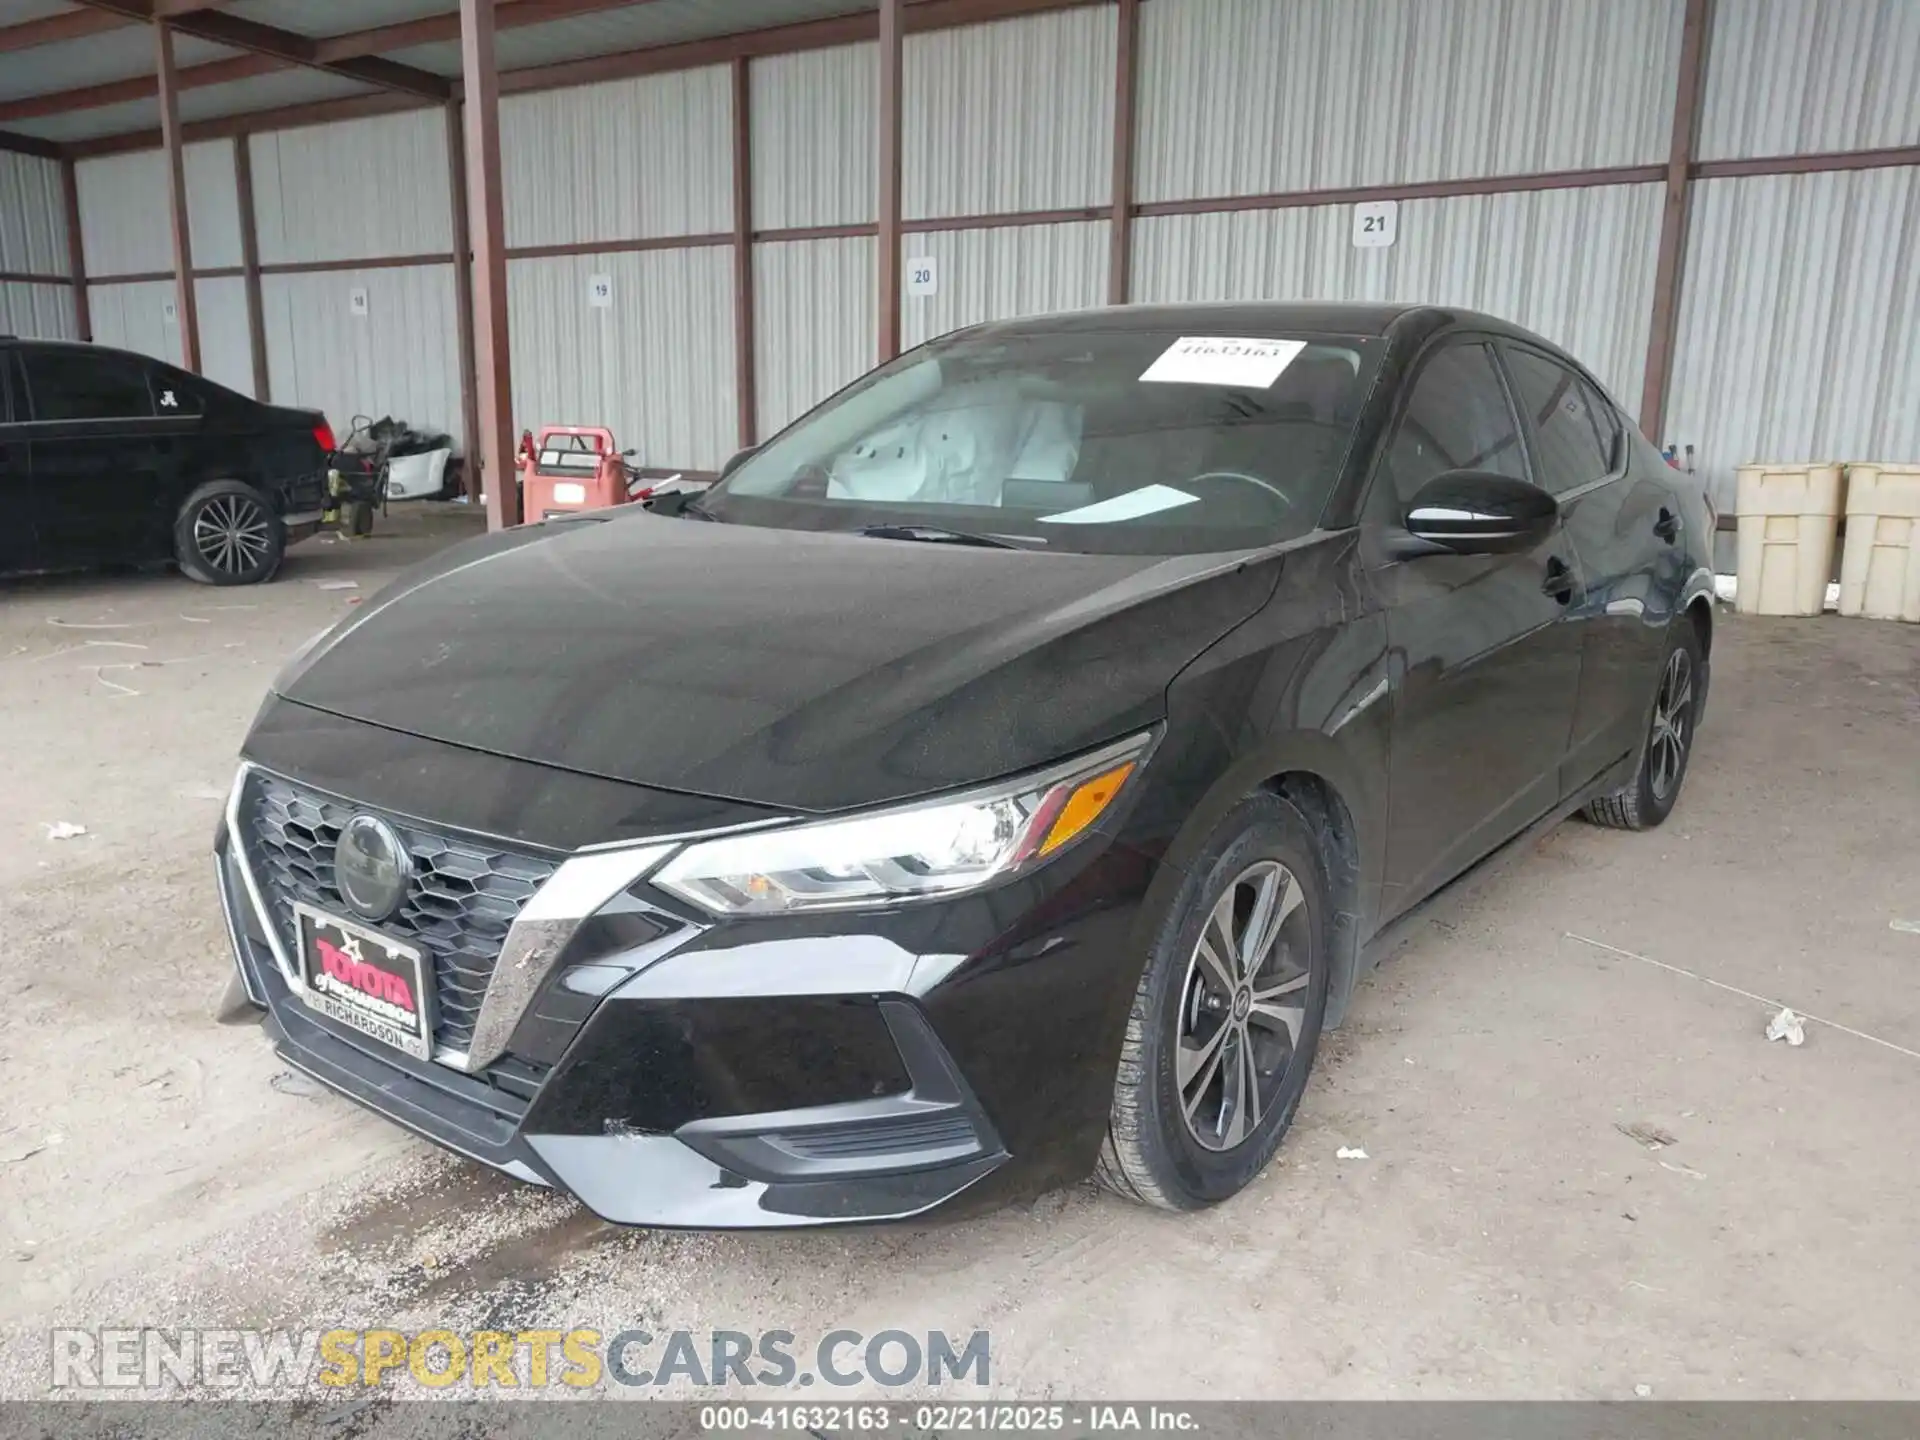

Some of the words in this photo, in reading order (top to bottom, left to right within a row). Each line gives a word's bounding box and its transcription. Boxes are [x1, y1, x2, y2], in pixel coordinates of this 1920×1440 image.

[1363, 215, 1385, 232] 21
[914, 269, 931, 284] 20
[595, 283, 608, 297] 19
[315, 936, 416, 1013] TOYOTA
[324, 1000, 405, 1049] RICHARDSON
